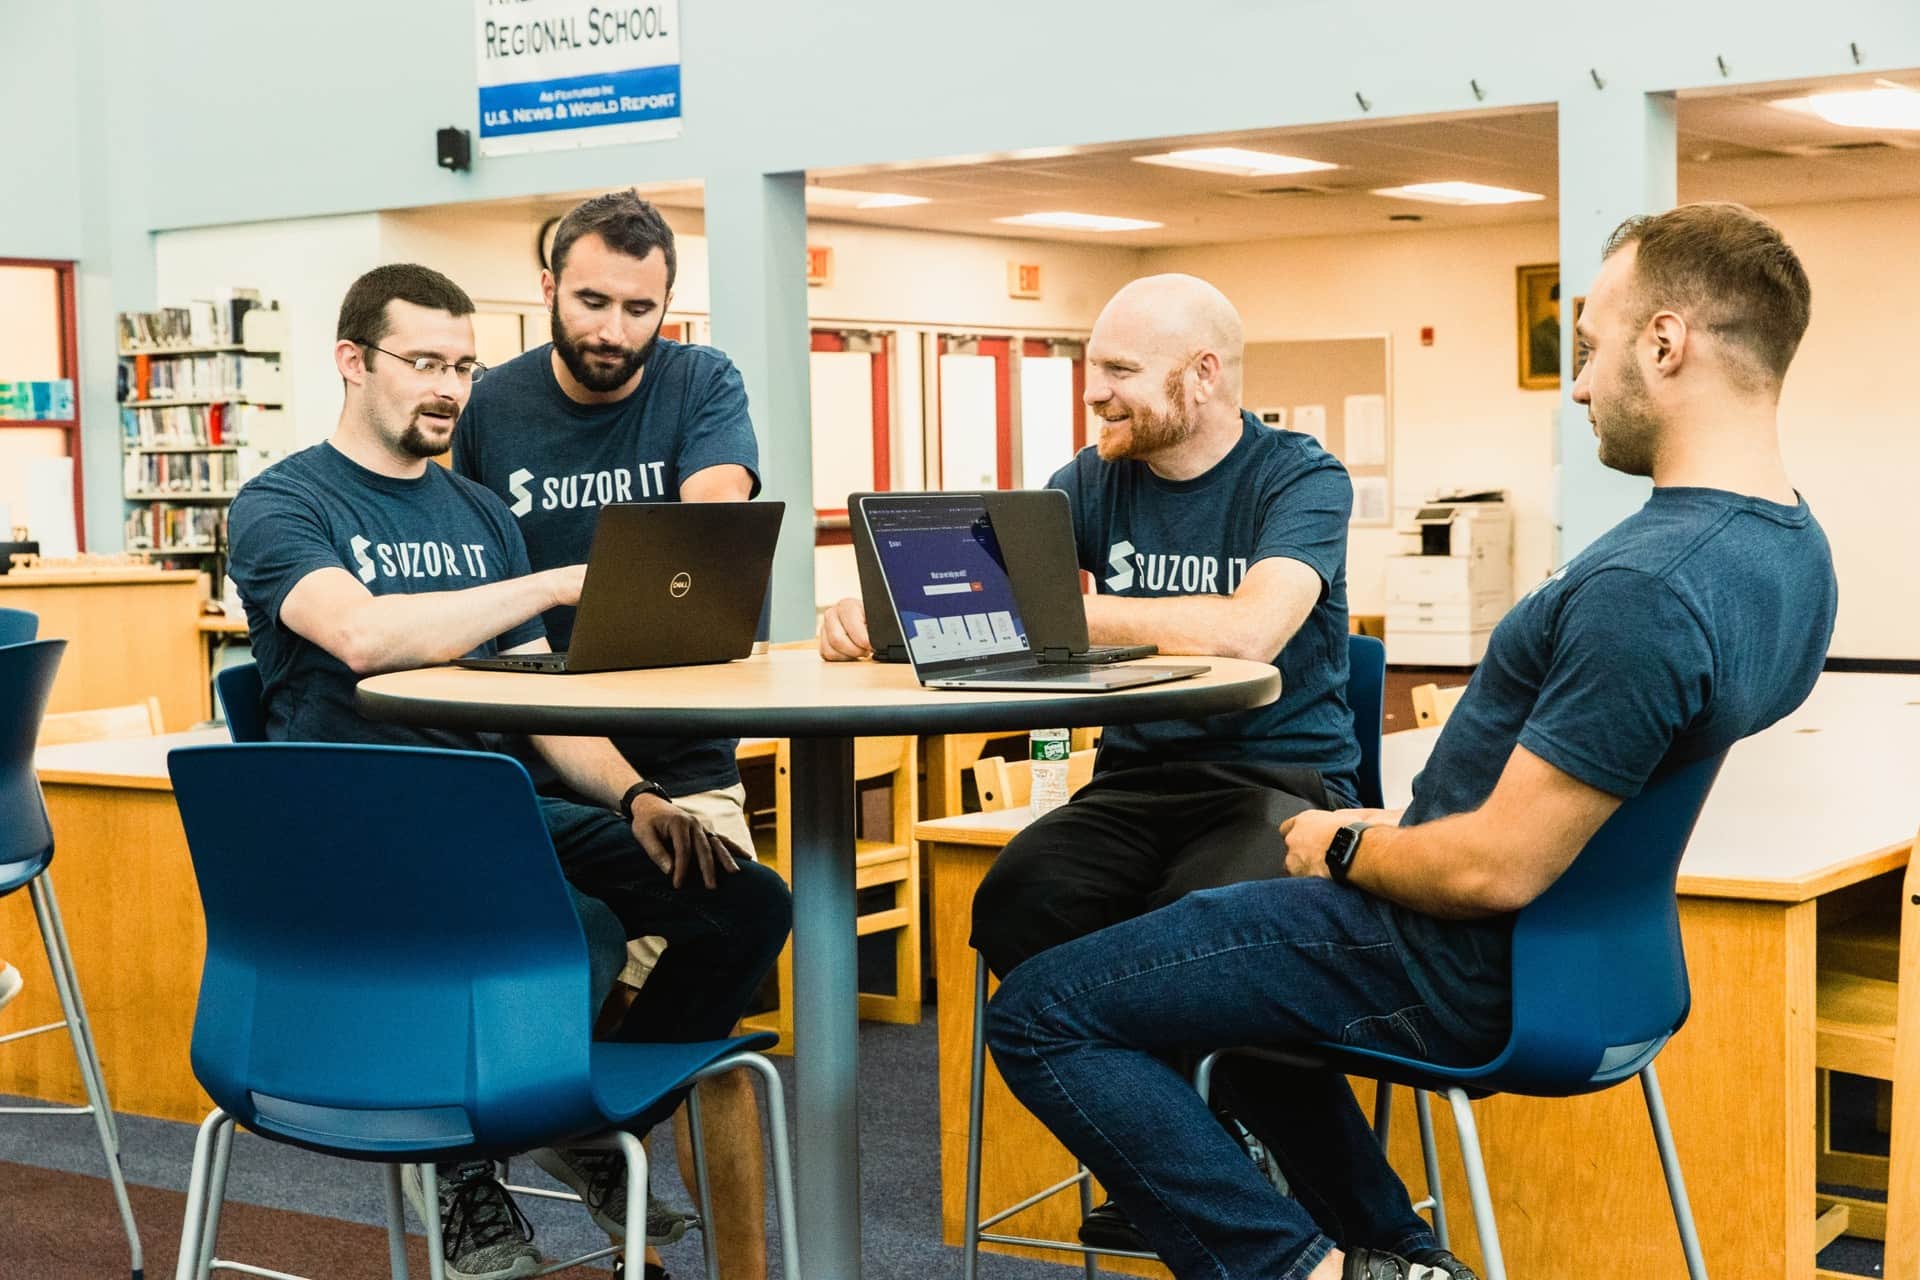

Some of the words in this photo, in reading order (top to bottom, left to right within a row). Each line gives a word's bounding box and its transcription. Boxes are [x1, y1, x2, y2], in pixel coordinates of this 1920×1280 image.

[485, 17, 581, 58] REGIONAL
[589, 6, 667, 46] SCHOOL
[513, 106, 553, 123] NEWS
[555, 103, 568, 119] &
[569, 99, 618, 117] WORLD
[620, 93, 676, 112] REPORT
[542, 468, 633, 510] SUZOR
[639, 461, 665, 498] IT
[376, 541, 461, 579] SUZOR
[461, 544, 488, 579] IT
[1135, 552, 1219, 593] SUZOR
